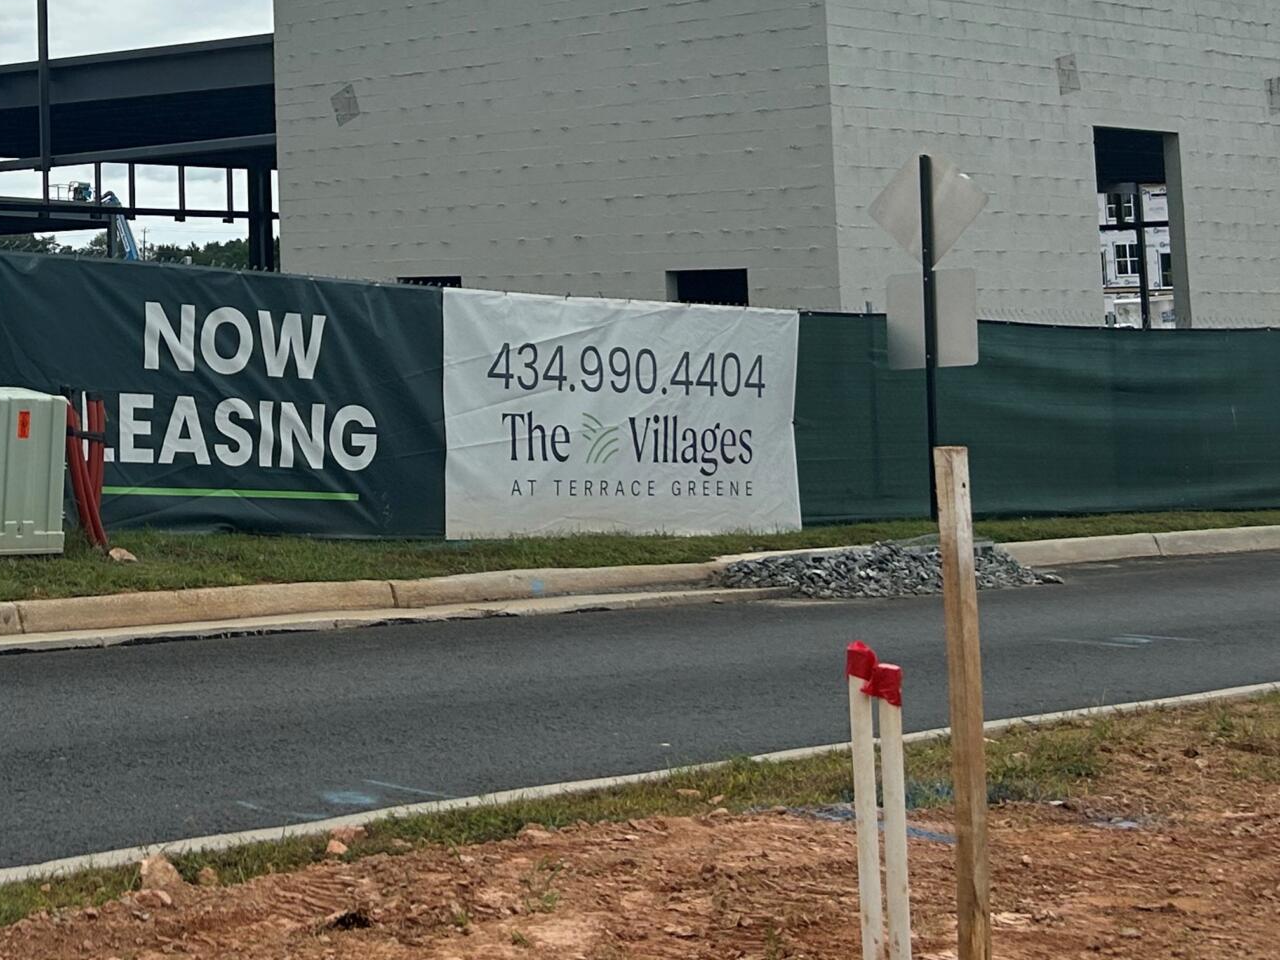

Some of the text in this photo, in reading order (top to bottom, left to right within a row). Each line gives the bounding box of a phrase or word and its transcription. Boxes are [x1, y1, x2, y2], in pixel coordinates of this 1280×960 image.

[143, 301, 326, 380] NOW
[487, 342, 766, 398] 434.990.4404
[502, 410, 753, 477] The Villages
[511, 479, 753, 497] AT TERRACE GREENE
